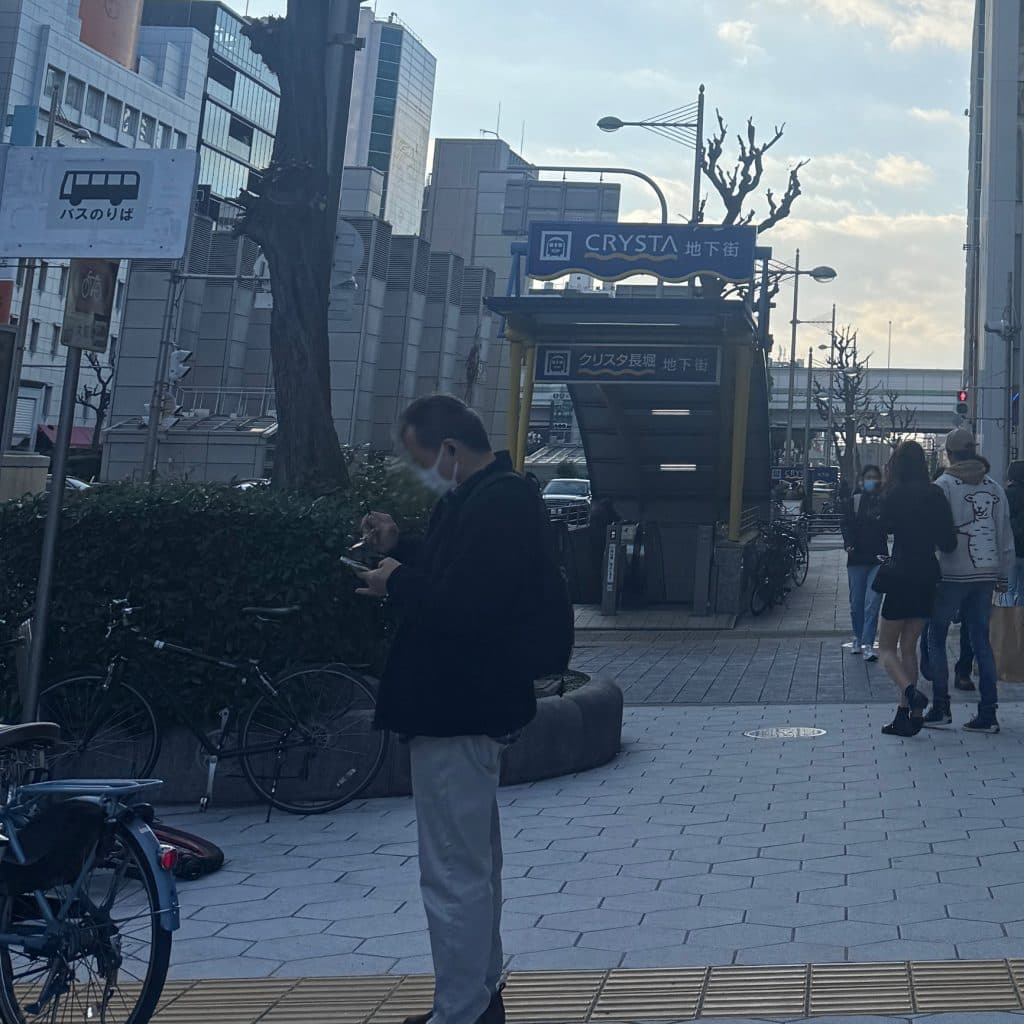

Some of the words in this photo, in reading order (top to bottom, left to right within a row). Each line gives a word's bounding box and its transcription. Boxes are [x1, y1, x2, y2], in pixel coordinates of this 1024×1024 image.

[60, 207, 134, 222] バスのりば
[585, 233, 679, 252] CRYSTA
[685, 240, 740, 258] 地下街
[579, 353, 656, 368] クリスタ長堀
[663, 358, 708, 373] 地下街
